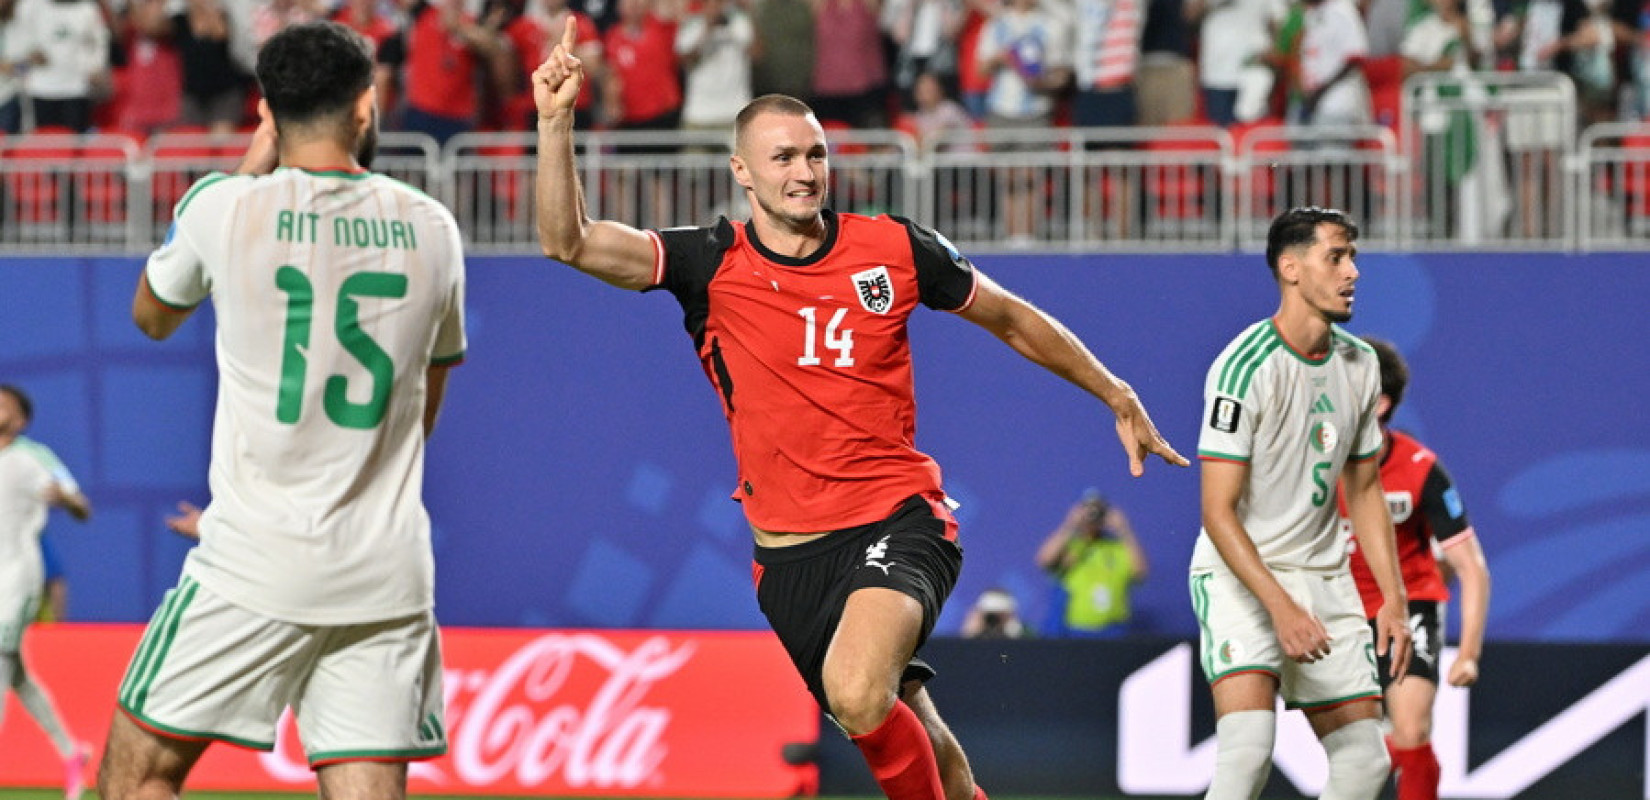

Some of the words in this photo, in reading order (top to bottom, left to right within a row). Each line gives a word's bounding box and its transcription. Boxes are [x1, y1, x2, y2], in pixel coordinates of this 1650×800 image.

[276, 209, 320, 244] AIT
[334, 216, 417, 250] NOURI
[275, 265, 408, 429] 15
[797, 306, 855, 367] 14
[1311, 461, 1332, 507] 5
